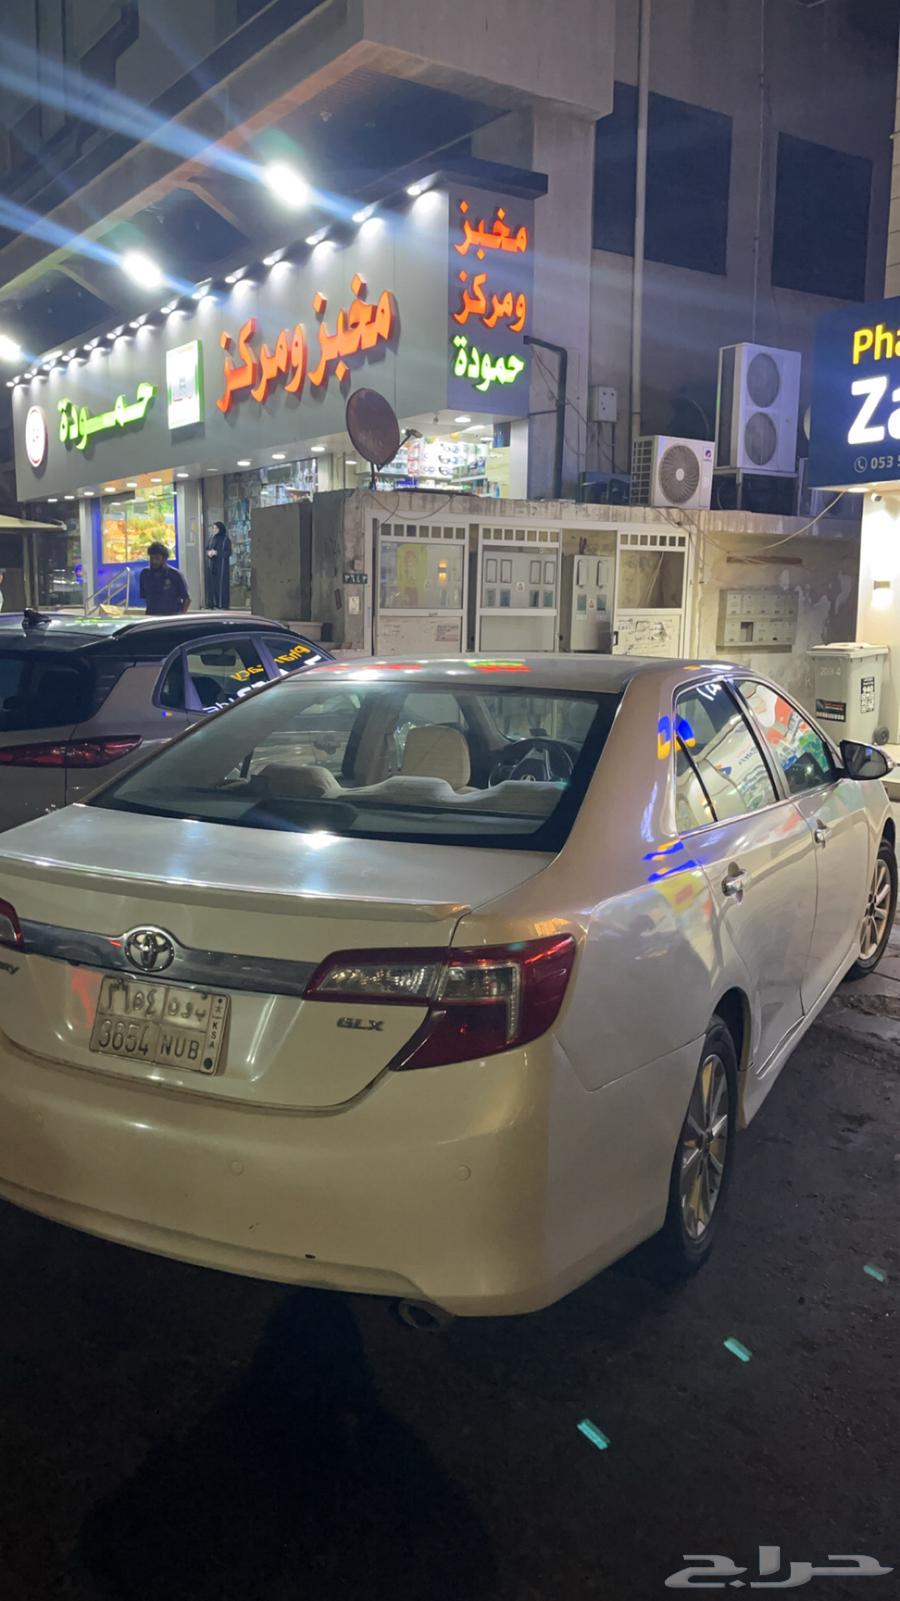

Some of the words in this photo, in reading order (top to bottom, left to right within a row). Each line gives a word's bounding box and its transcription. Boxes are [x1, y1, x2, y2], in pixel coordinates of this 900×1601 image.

[454, 200, 528, 260] مخبز
[307, 273, 397, 387] مخبز
[453, 271, 527, 332] ومركز
[215, 317, 308, 413] ومركز
[452, 335, 525, 392] حمودة
[57, 382, 158, 450] حمودة
[870, 456, 894, 469] 053
[97, 1019, 150, 1056] 3654
[160, 1034, 200, 1061] NUB
[336, 1016, 385, 1031] GLX
